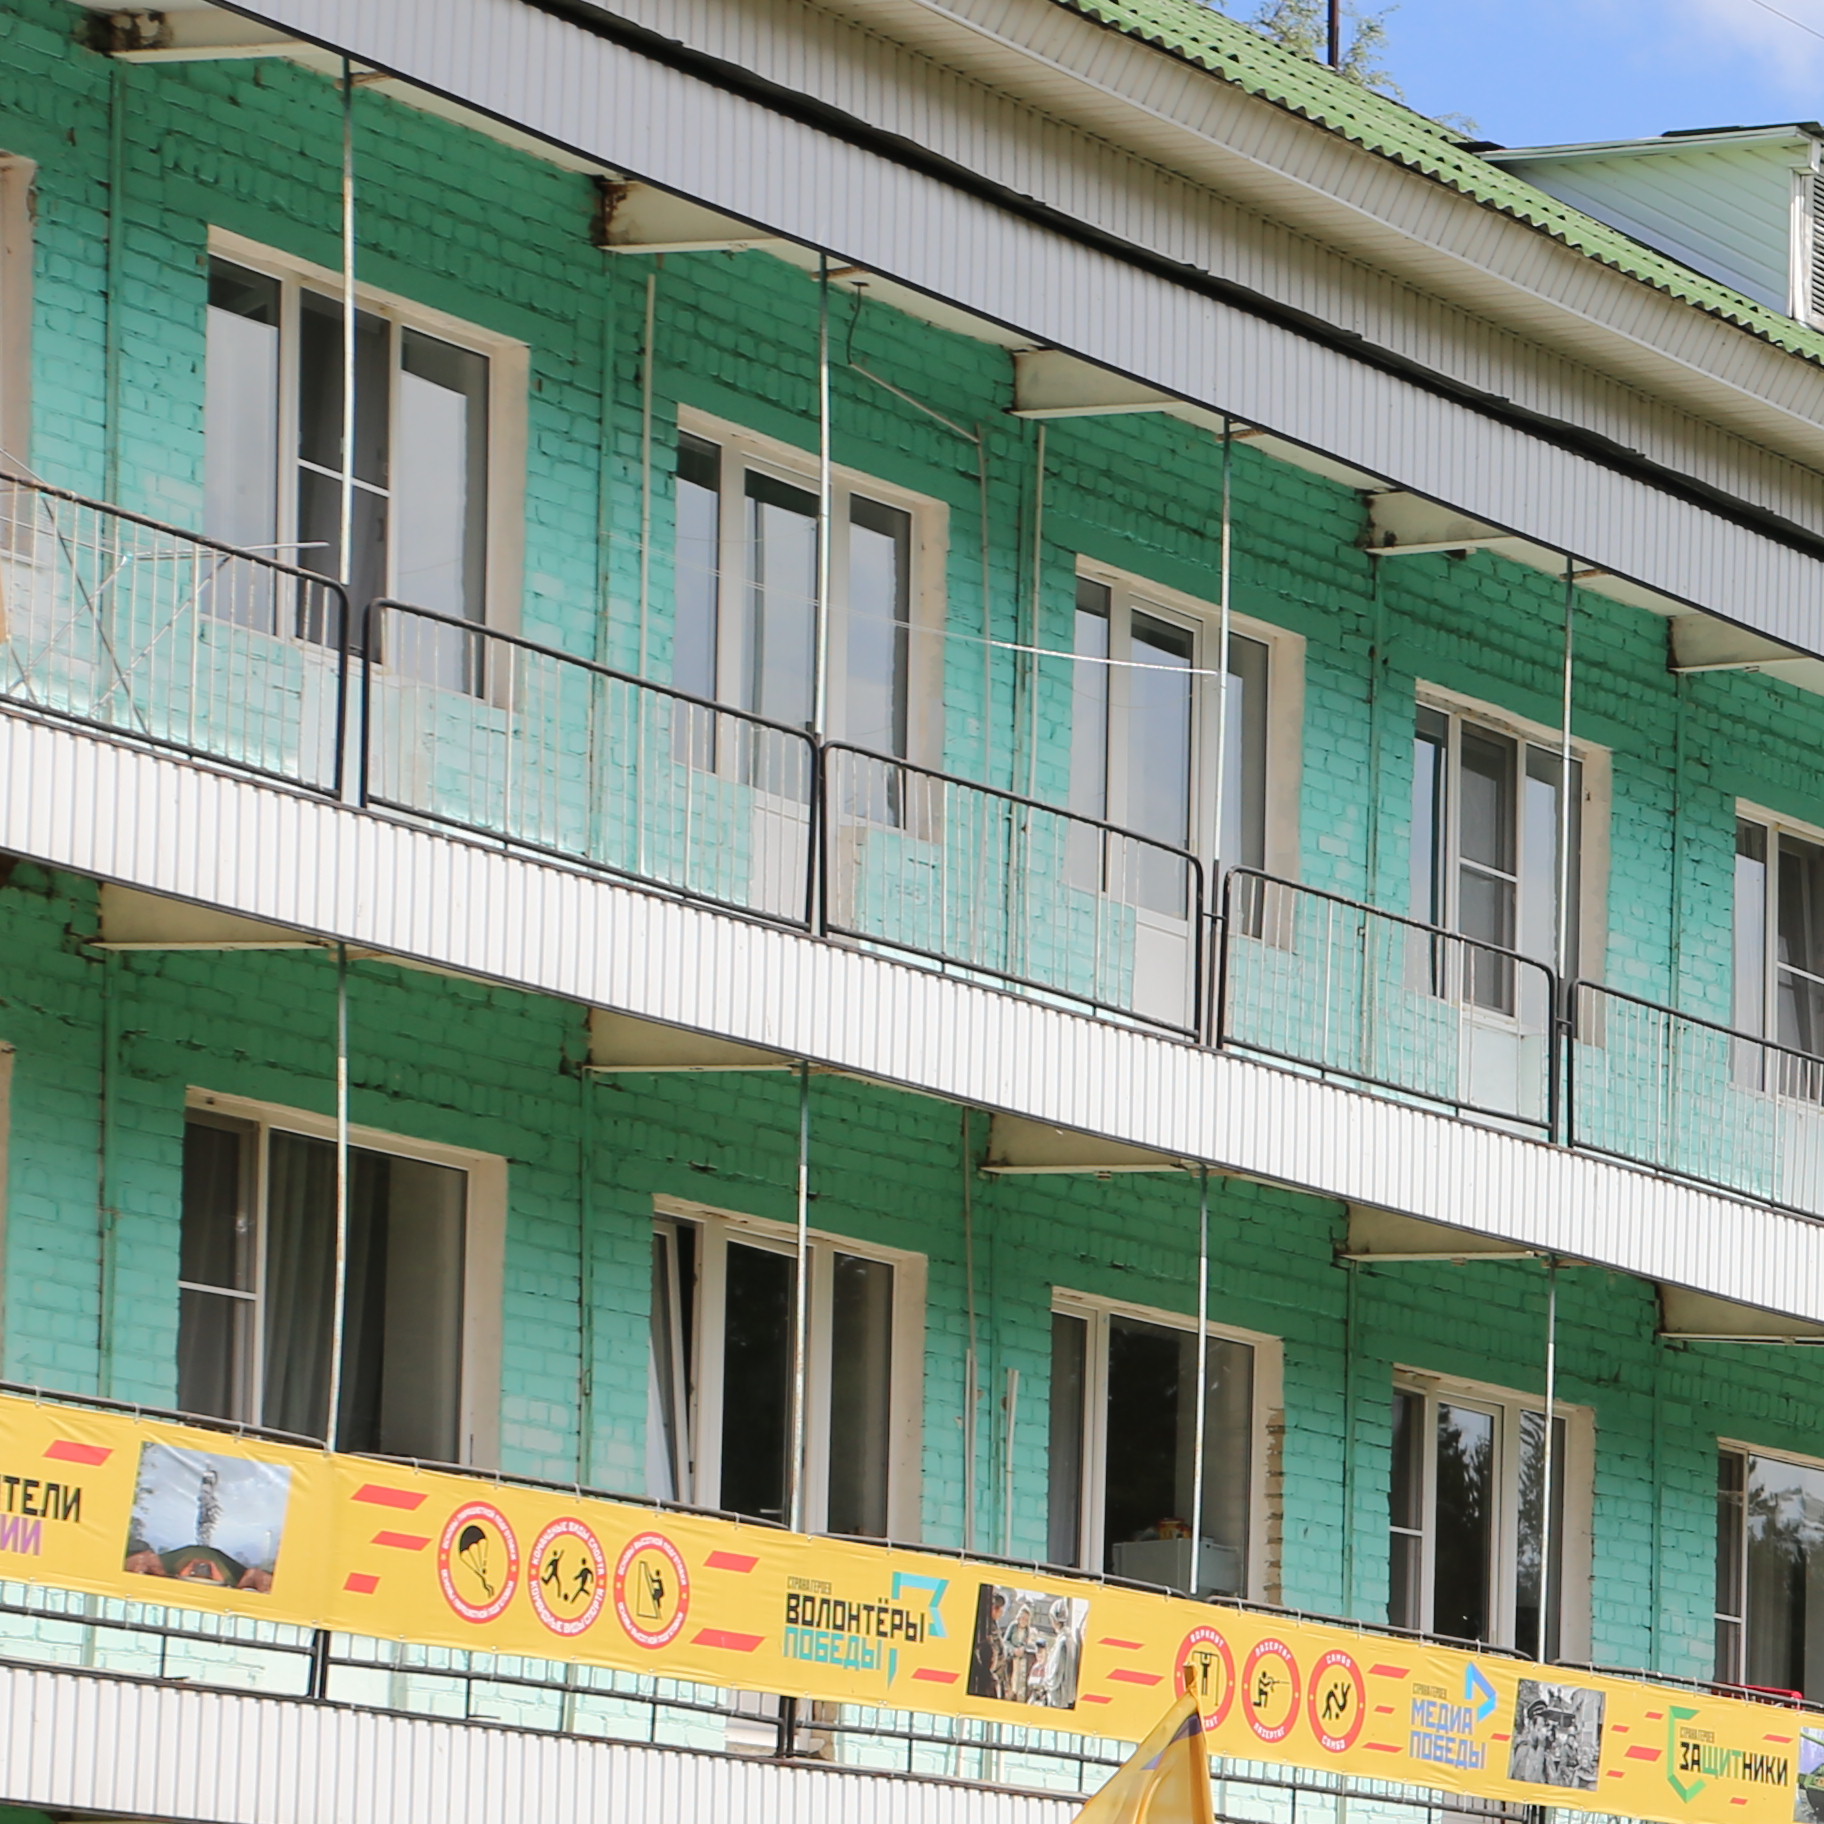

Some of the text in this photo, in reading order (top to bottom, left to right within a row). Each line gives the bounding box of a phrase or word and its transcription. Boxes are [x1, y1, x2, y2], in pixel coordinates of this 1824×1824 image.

[0, 1474, 81, 1523] ТЕЛИ
[786, 1592, 925, 1643] ВОЛОНТЁРЫ
[784, 1626, 882, 1671] ПОБЕДЫ
[1190, 1628, 1224, 1647] ВОРКАУТ
[1254, 1642, 1291, 1661] ЛАЗЕРТАГ
[1326, 1653, 1352, 1668] САМБО
[1411, 1697, 1473, 1735] МЕДИА
[1322, 1735, 1346, 1750] САМБО
[1409, 1730, 1486, 1770] ПОБЕДЫ
[1679, 1741, 1788, 1787] ЗАЩИТНИКИ
